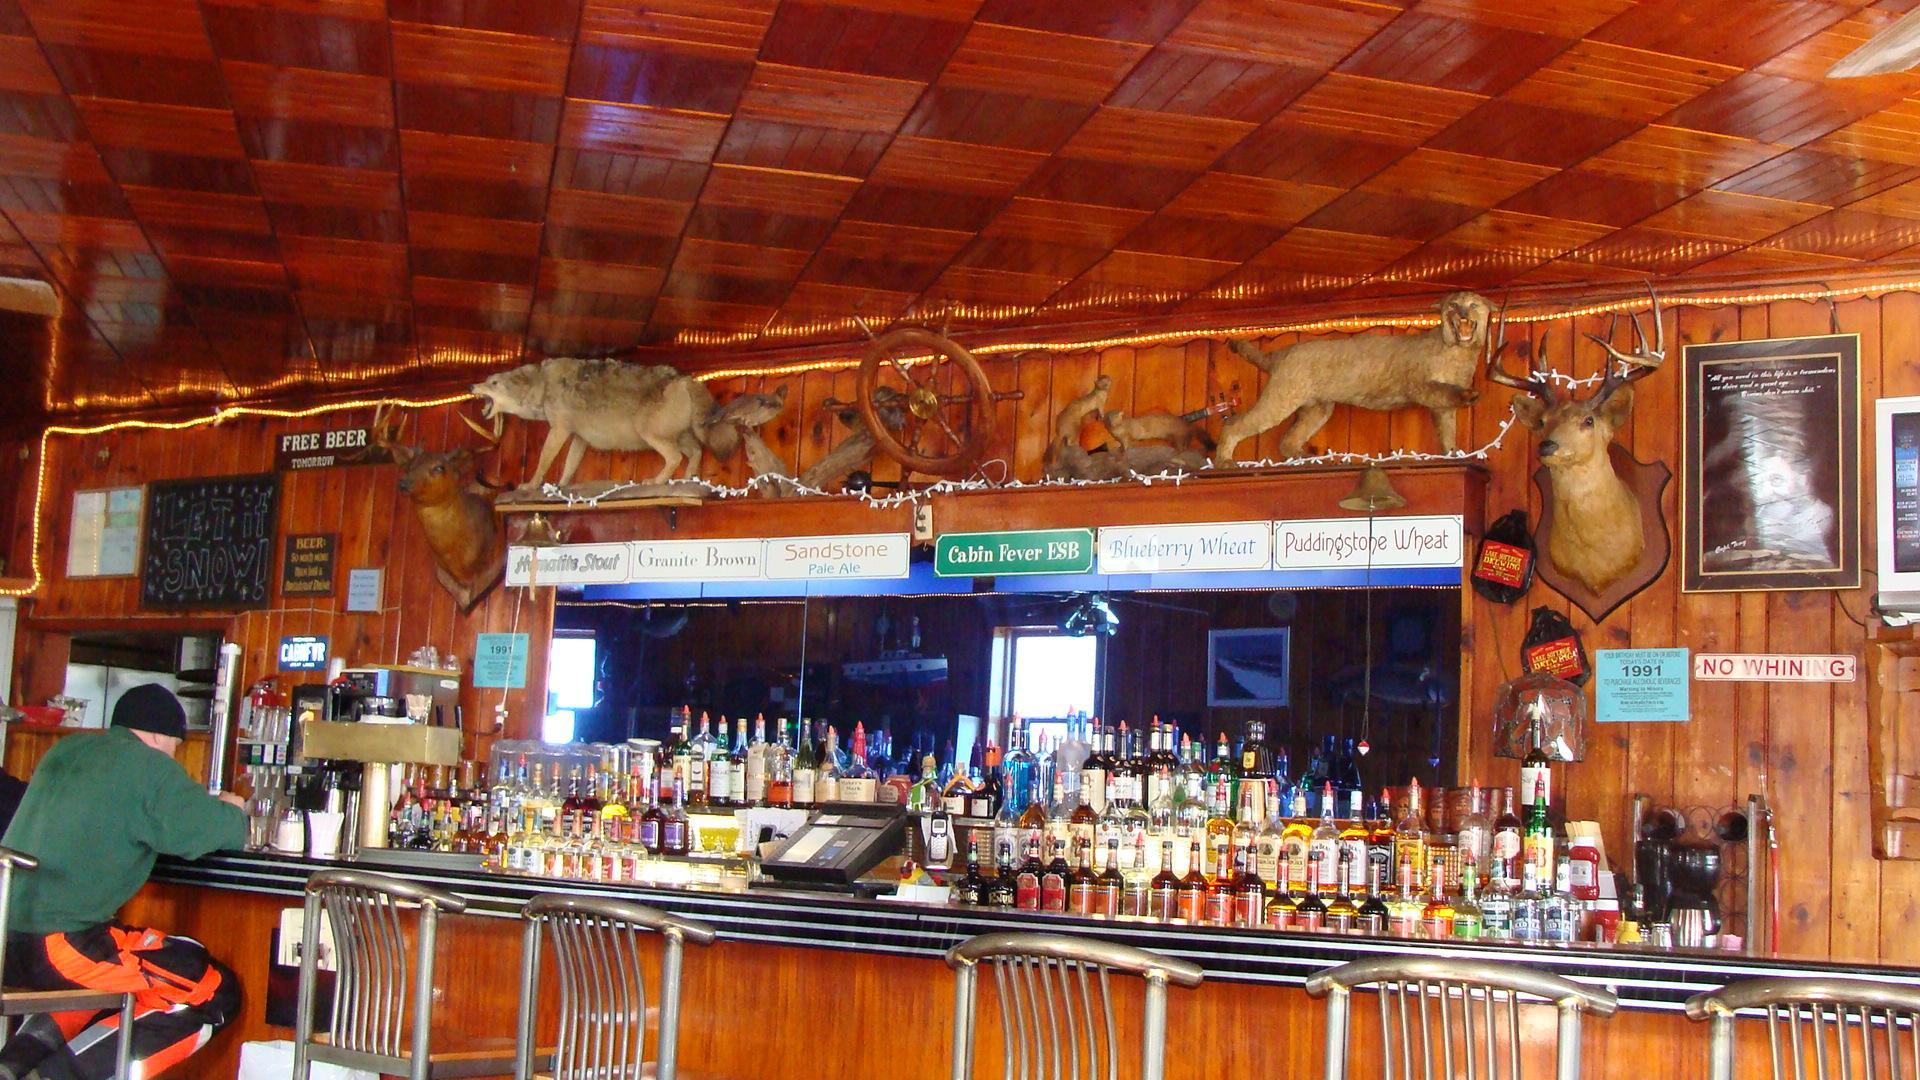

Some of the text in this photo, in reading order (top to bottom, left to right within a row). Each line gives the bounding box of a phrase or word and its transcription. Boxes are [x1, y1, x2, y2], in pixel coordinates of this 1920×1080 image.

[282, 429, 367, 452] FREE BEER
[291, 456, 335, 469] TOMORROW
[162, 495, 234, 541] LET
[948, 541, 1080, 564] Cabin Fever ESB
[1109, 531, 1257, 567] Blueberry Wheat
[1285, 526, 1449, 561] Puddingstone Wheat
[515, 552, 621, 574] Hmatite Stout
[638, 546, 756, 568] Granite Brown
[164, 539, 270, 600] SNOW!
[809, 562, 861, 576] Pale Ale
[491, 645, 512, 654] 1991
[1621, 665, 1662, 677] 1991
[1703, 658, 1846, 677] NO WHINING
